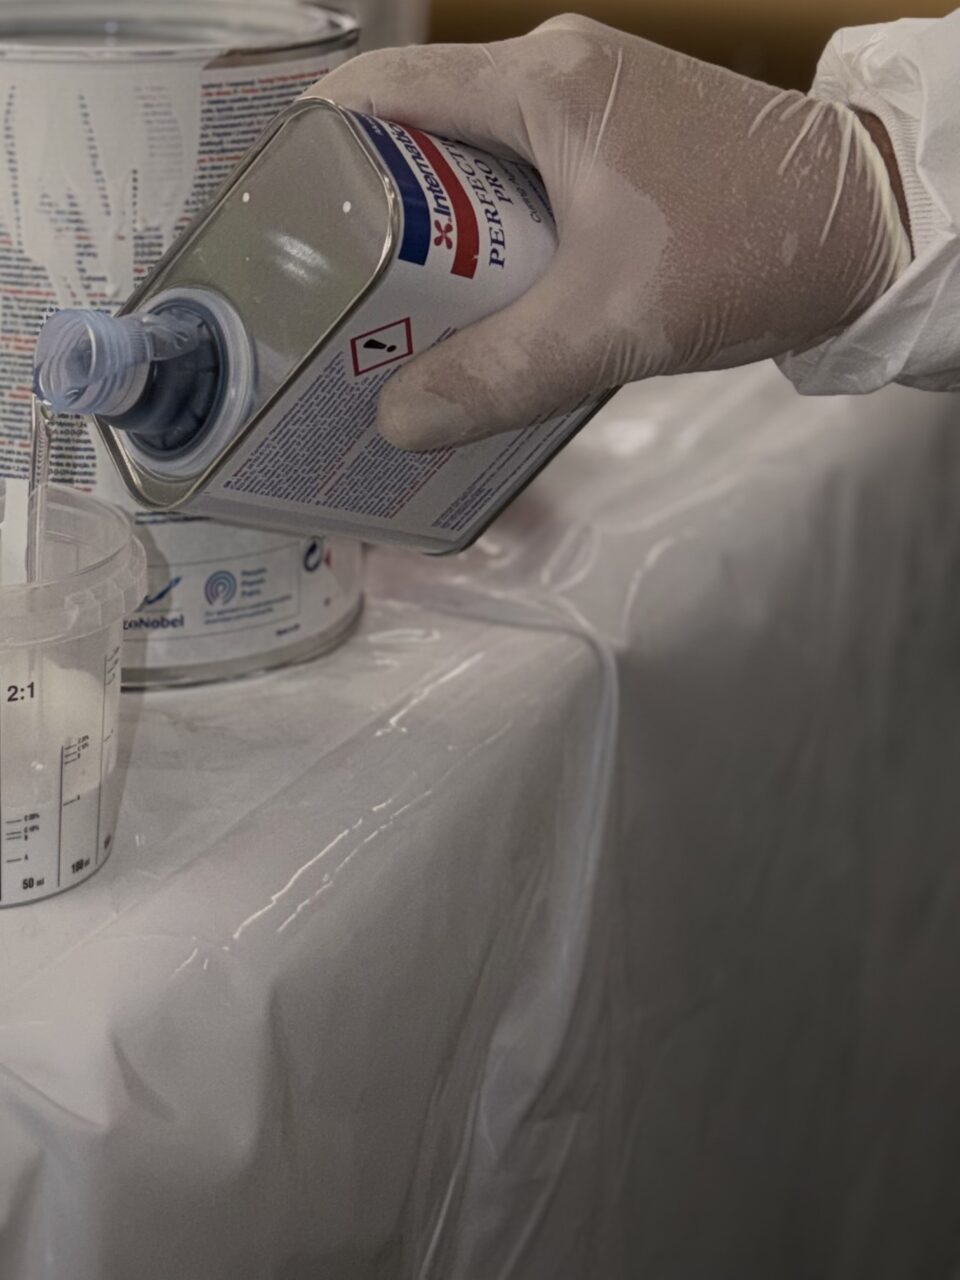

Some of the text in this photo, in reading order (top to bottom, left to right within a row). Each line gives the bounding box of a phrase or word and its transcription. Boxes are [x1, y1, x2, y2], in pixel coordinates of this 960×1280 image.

[390, 122, 452, 216] Internatio
[474, 158, 513, 205] PRO
[442, 139, 506, 269] PERFECTI
[7, 682, 36, 702] 2:1
[22, 877, 34, 890] 50
